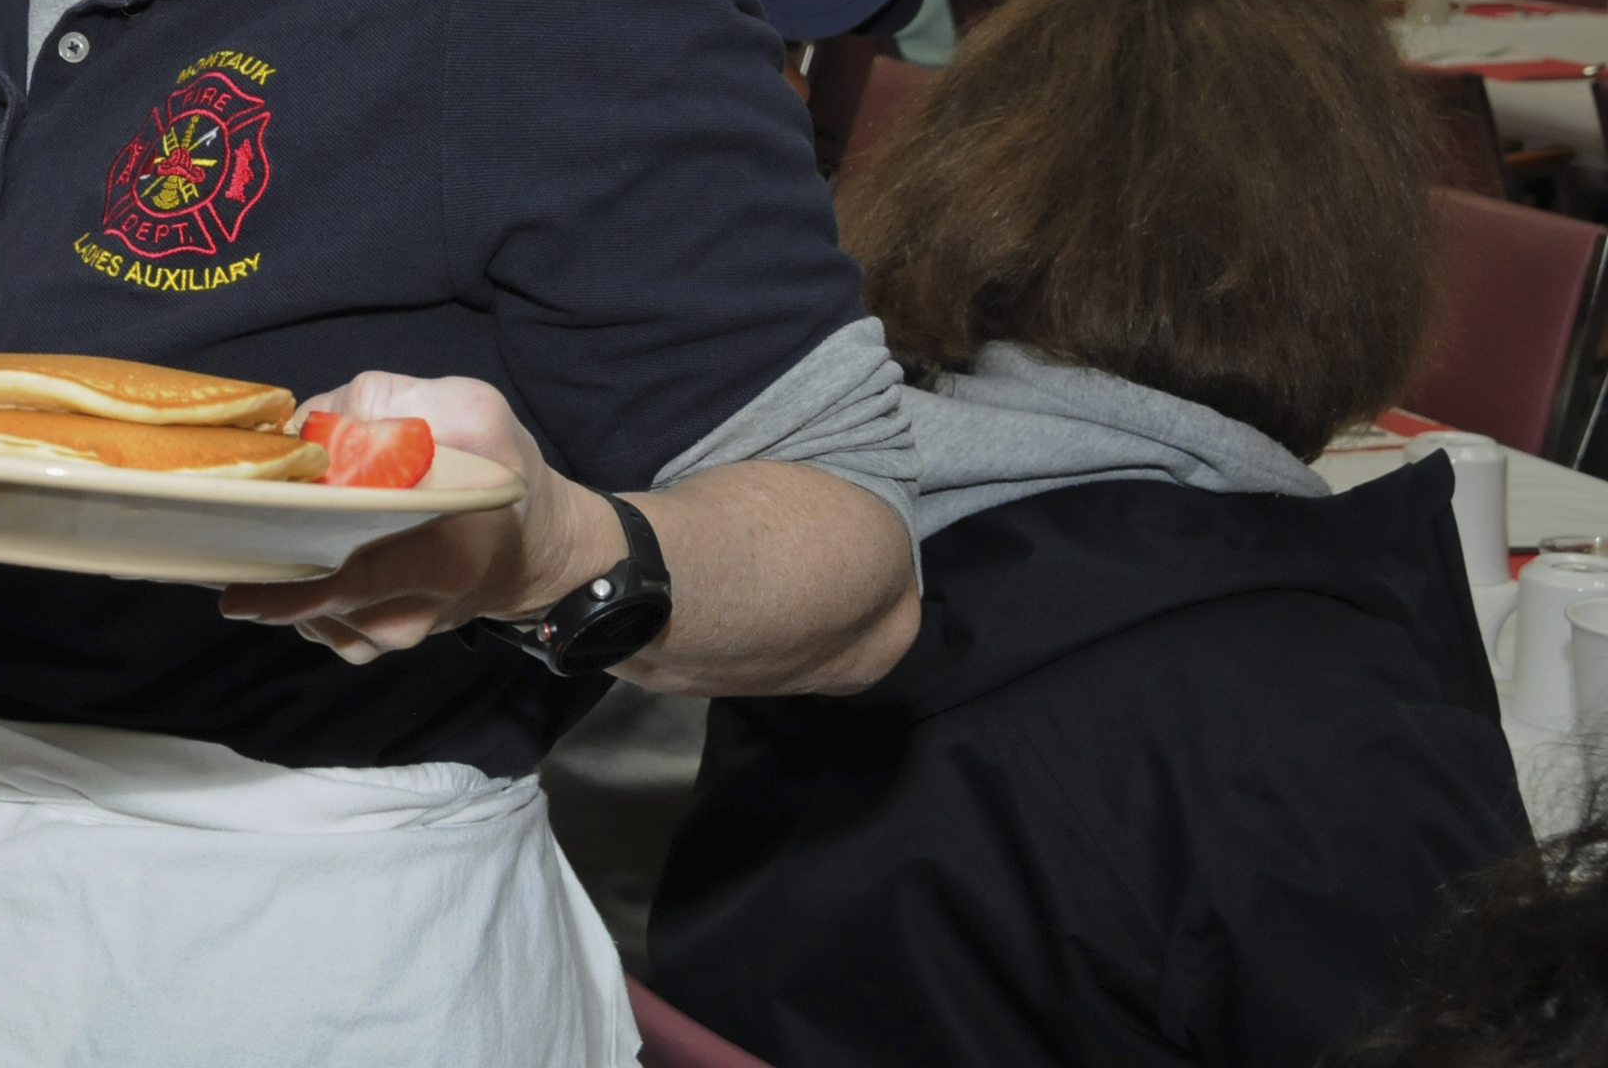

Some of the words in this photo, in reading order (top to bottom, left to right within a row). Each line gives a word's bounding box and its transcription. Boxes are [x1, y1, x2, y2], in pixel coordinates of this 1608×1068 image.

[176, 50, 277, 86] MONTAUK
[182, 87, 232, 113] FIRE
[121, 214, 193, 244] DEPT.
[73, 232, 124, 277] LADIES
[124, 252, 261, 291] AUXILIARY
